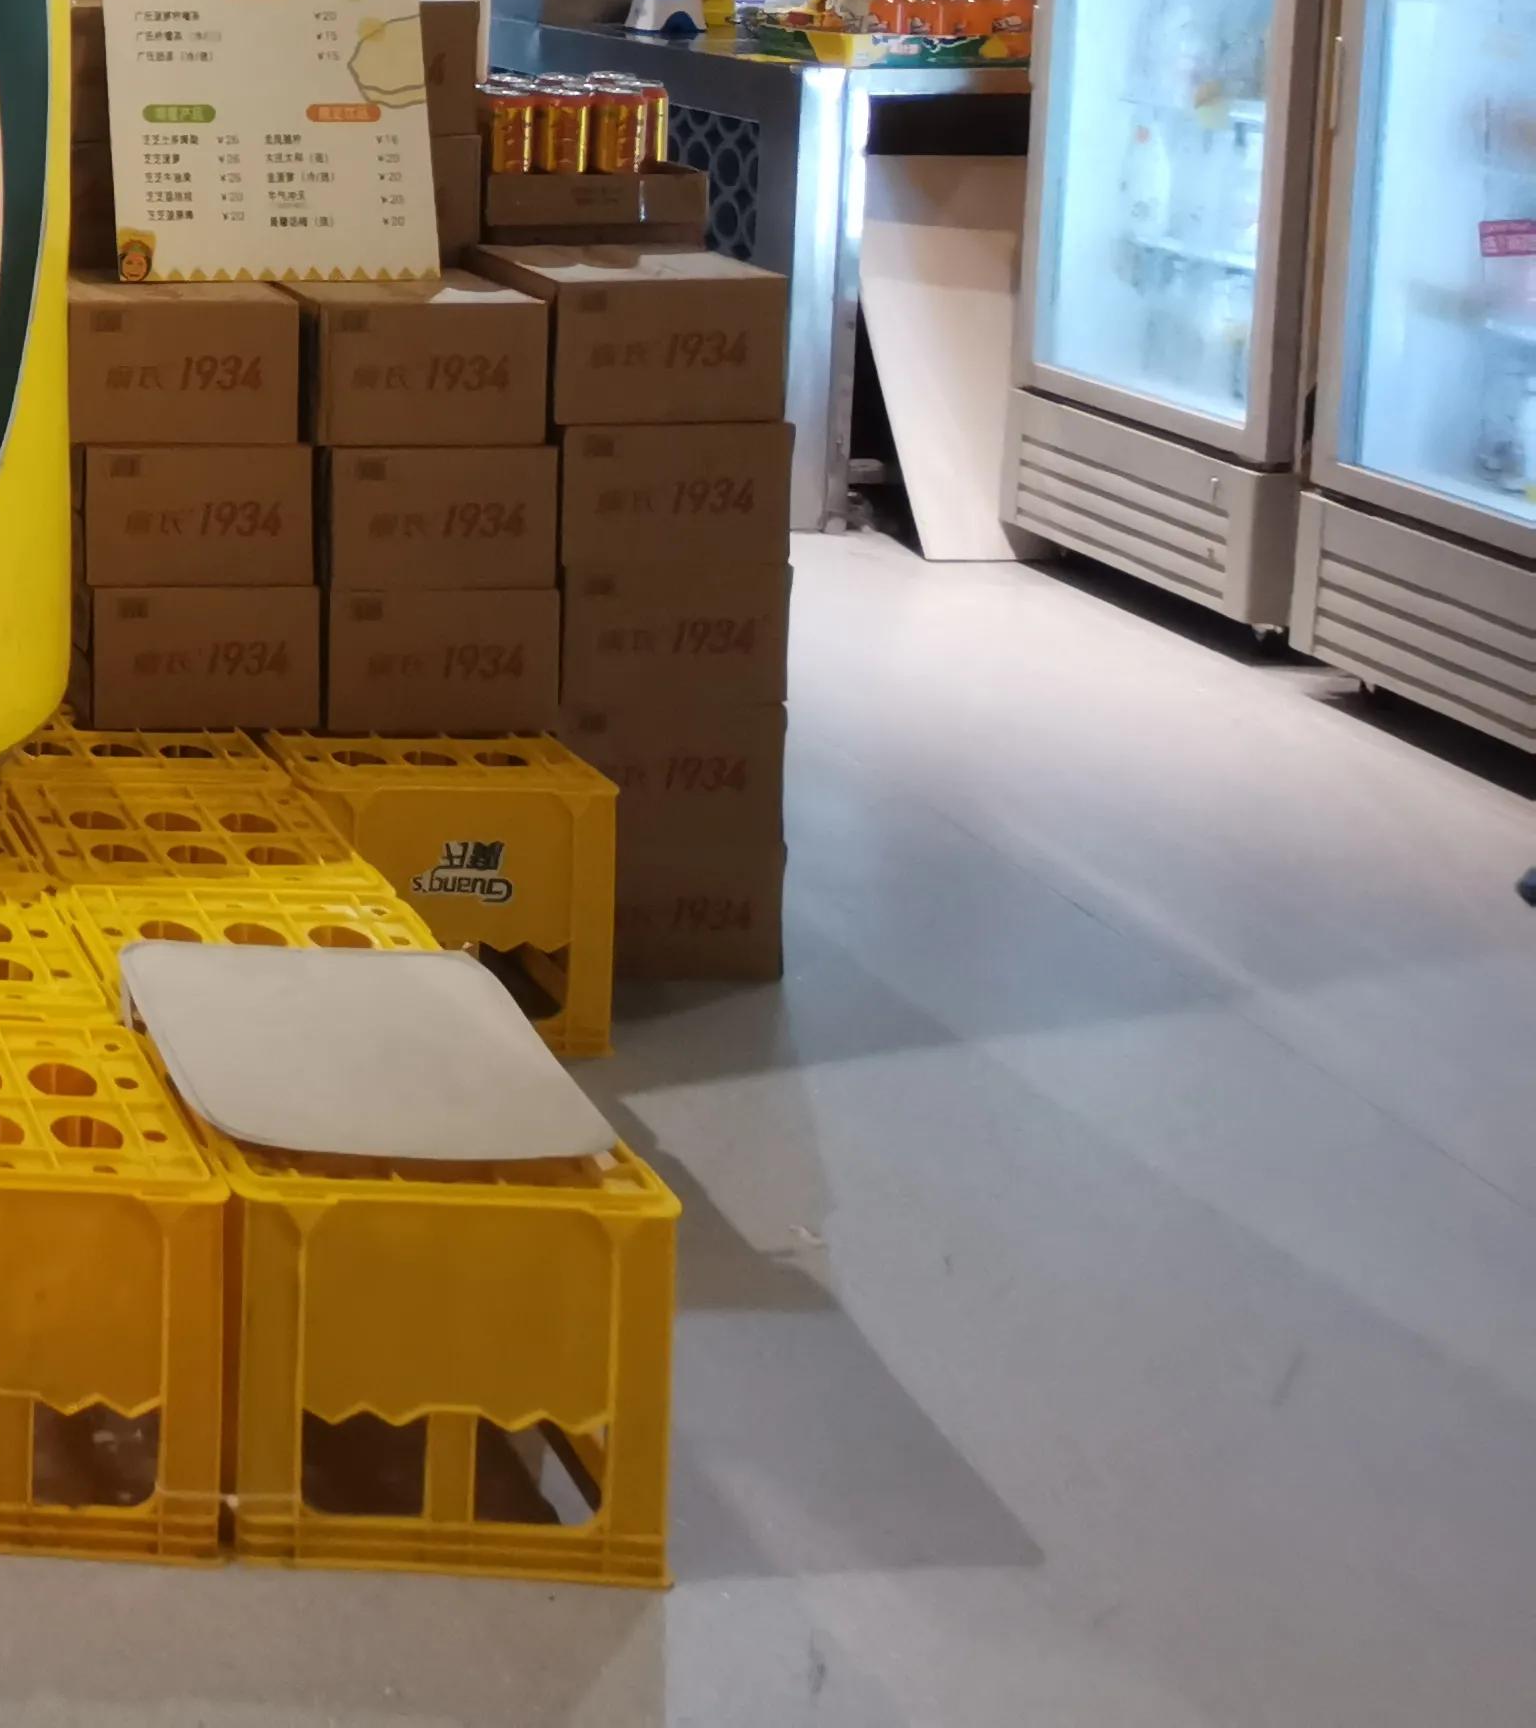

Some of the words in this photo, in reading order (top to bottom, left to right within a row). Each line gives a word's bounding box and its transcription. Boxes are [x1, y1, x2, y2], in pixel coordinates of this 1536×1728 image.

[664, 331, 751, 369] 1934
[178, 354, 264, 394] 1934
[424, 354, 511, 394] 1934
[671, 477, 757, 515] 1934
[198, 500, 284, 538] 1934
[441, 502, 528, 539] 1934
[205, 640, 292, 679] 1934
[441, 642, 526, 680] 1934
